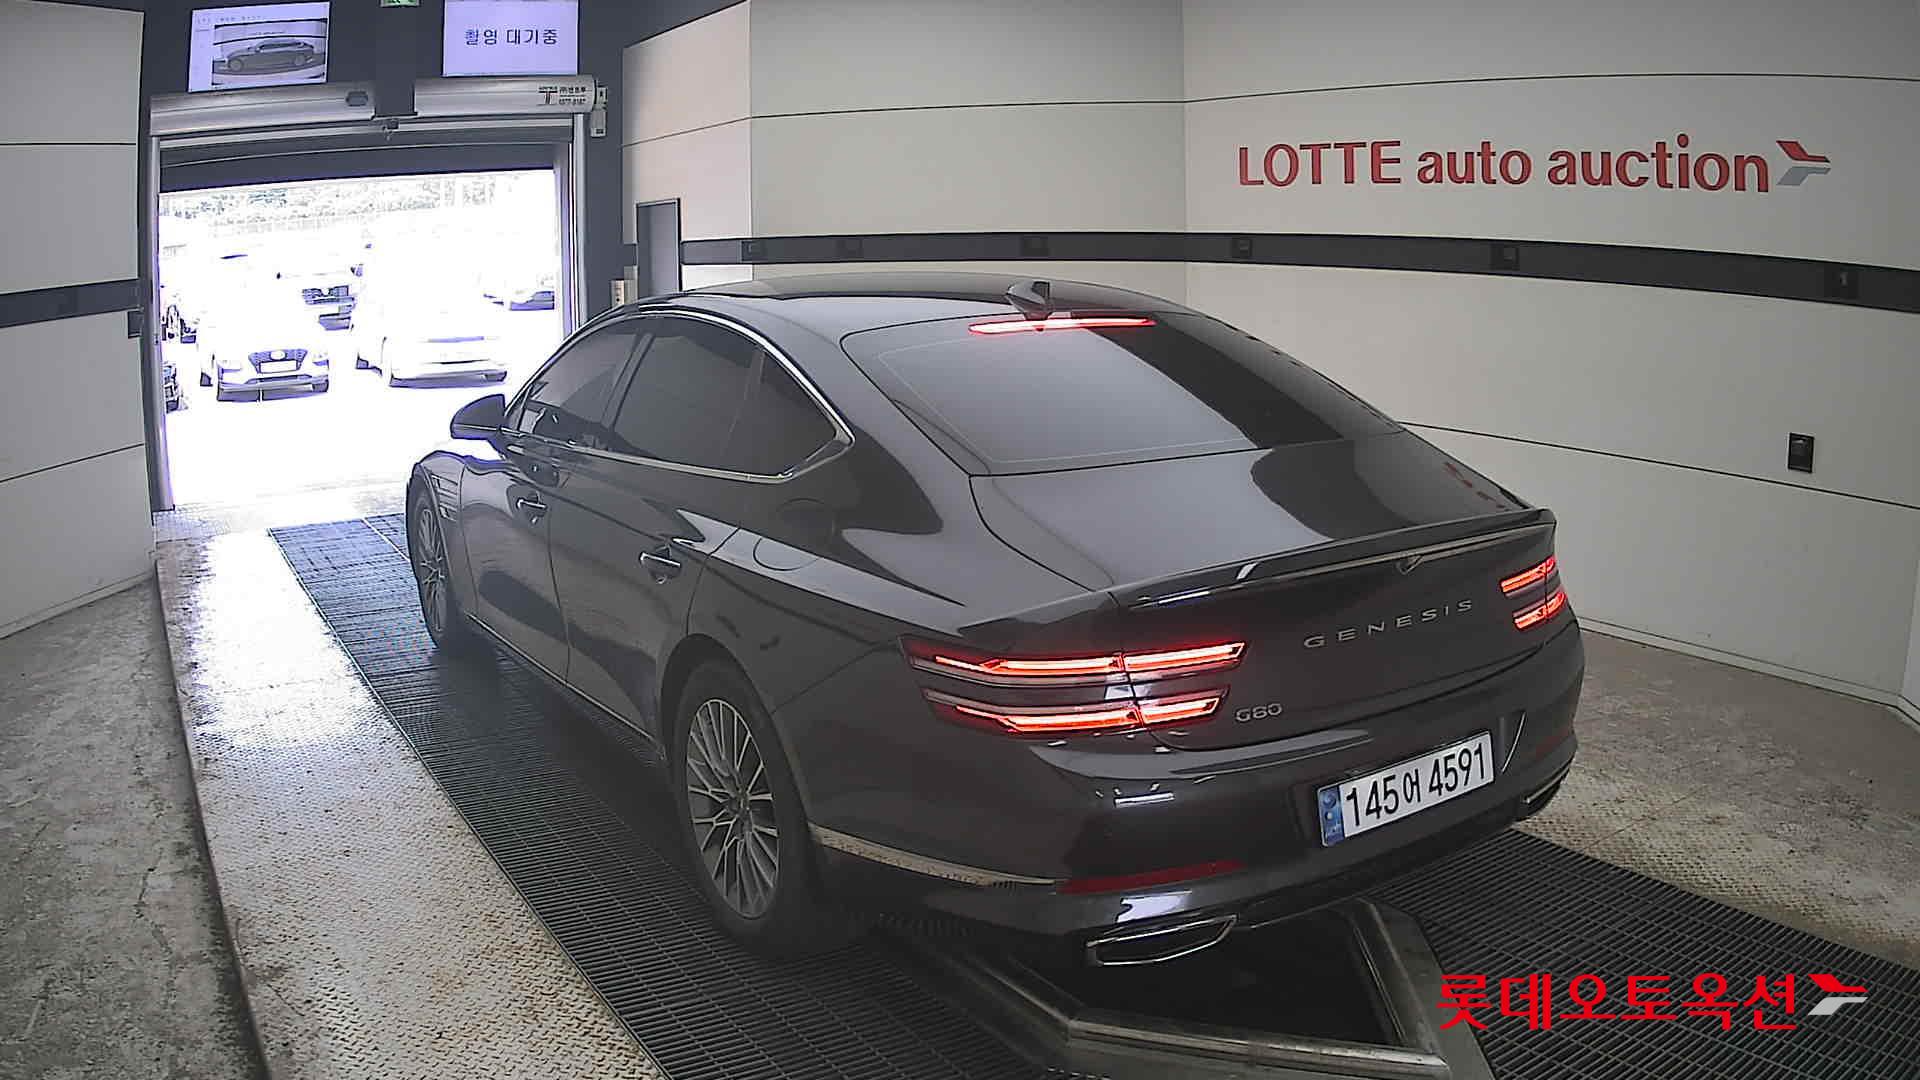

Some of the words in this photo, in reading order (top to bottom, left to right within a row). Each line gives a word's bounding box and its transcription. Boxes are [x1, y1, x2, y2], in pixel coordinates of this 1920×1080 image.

[506, 28, 559, 45] 대기중
[1239, 140, 1401, 187] LOTTE
[1416, 140, 1532, 186] auto
[1547, 132, 1769, 193] auction
[1303, 599, 1474, 649] GENESIS
[1235, 702, 1283, 722] G80
[1345, 768, 1422, 827] 145어
[1428, 742, 1485, 797] 4591
